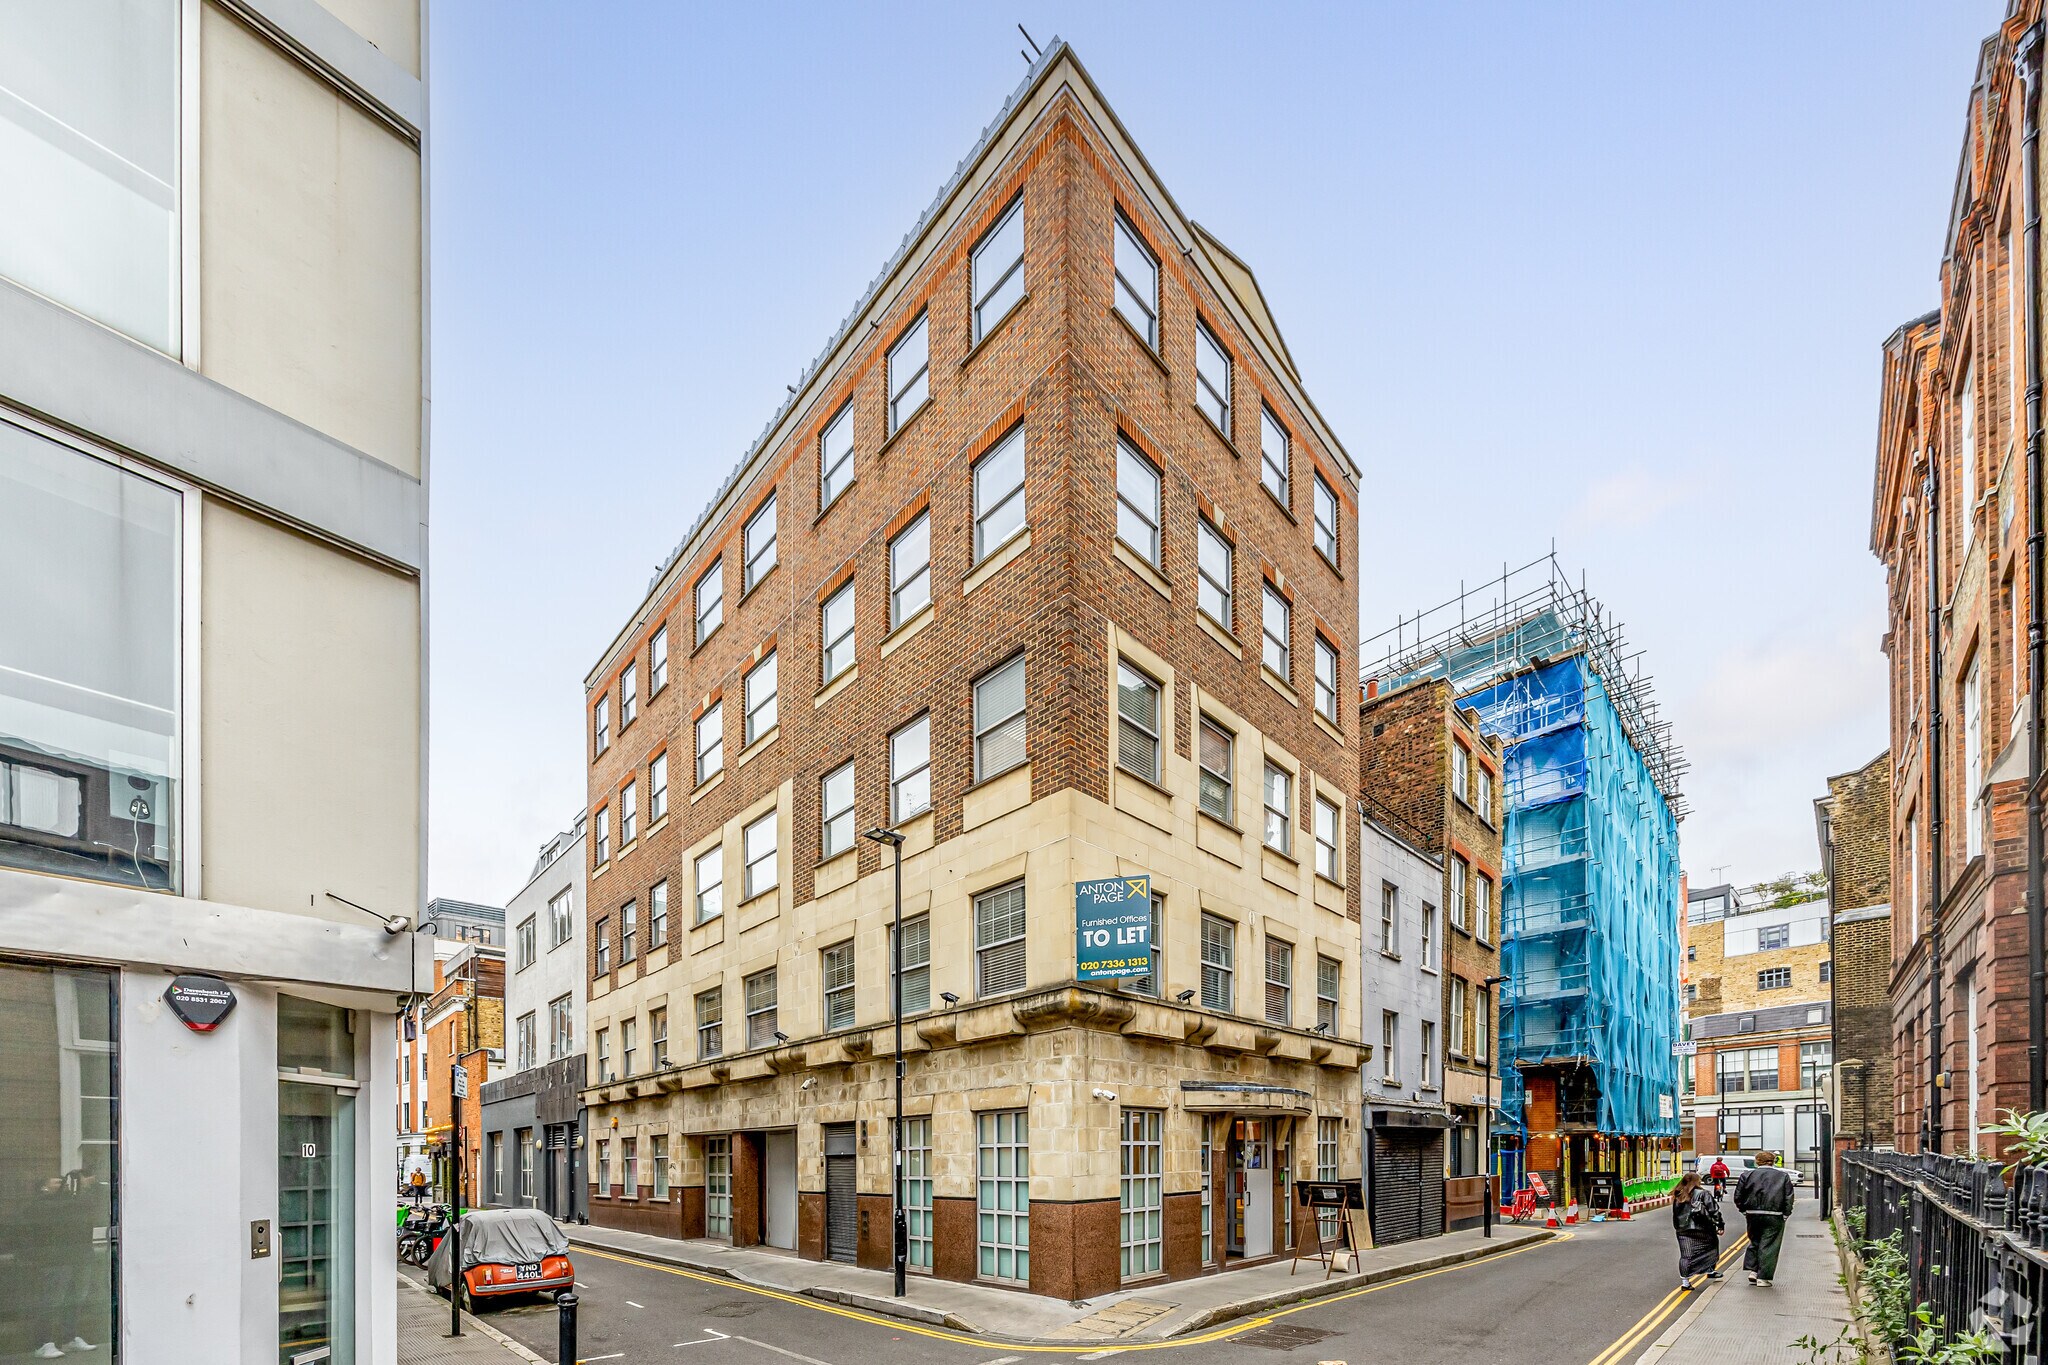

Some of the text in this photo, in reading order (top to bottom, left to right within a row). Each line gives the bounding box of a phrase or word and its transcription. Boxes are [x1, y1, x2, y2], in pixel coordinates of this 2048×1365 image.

[1079, 881, 1124, 896] ANTON
[1093, 892, 1124, 904] PAGE
[1081, 915, 1148, 927] Furnished Offices
[1083, 926, 1148, 948] TO LET
[1080, 957, 1148, 970] 020 7336 1313
[1090, 967, 1148, 976] antonpage.com
[303, 1144, 314, 1156] 10
[518, 1271, 540, 1279] 440L
